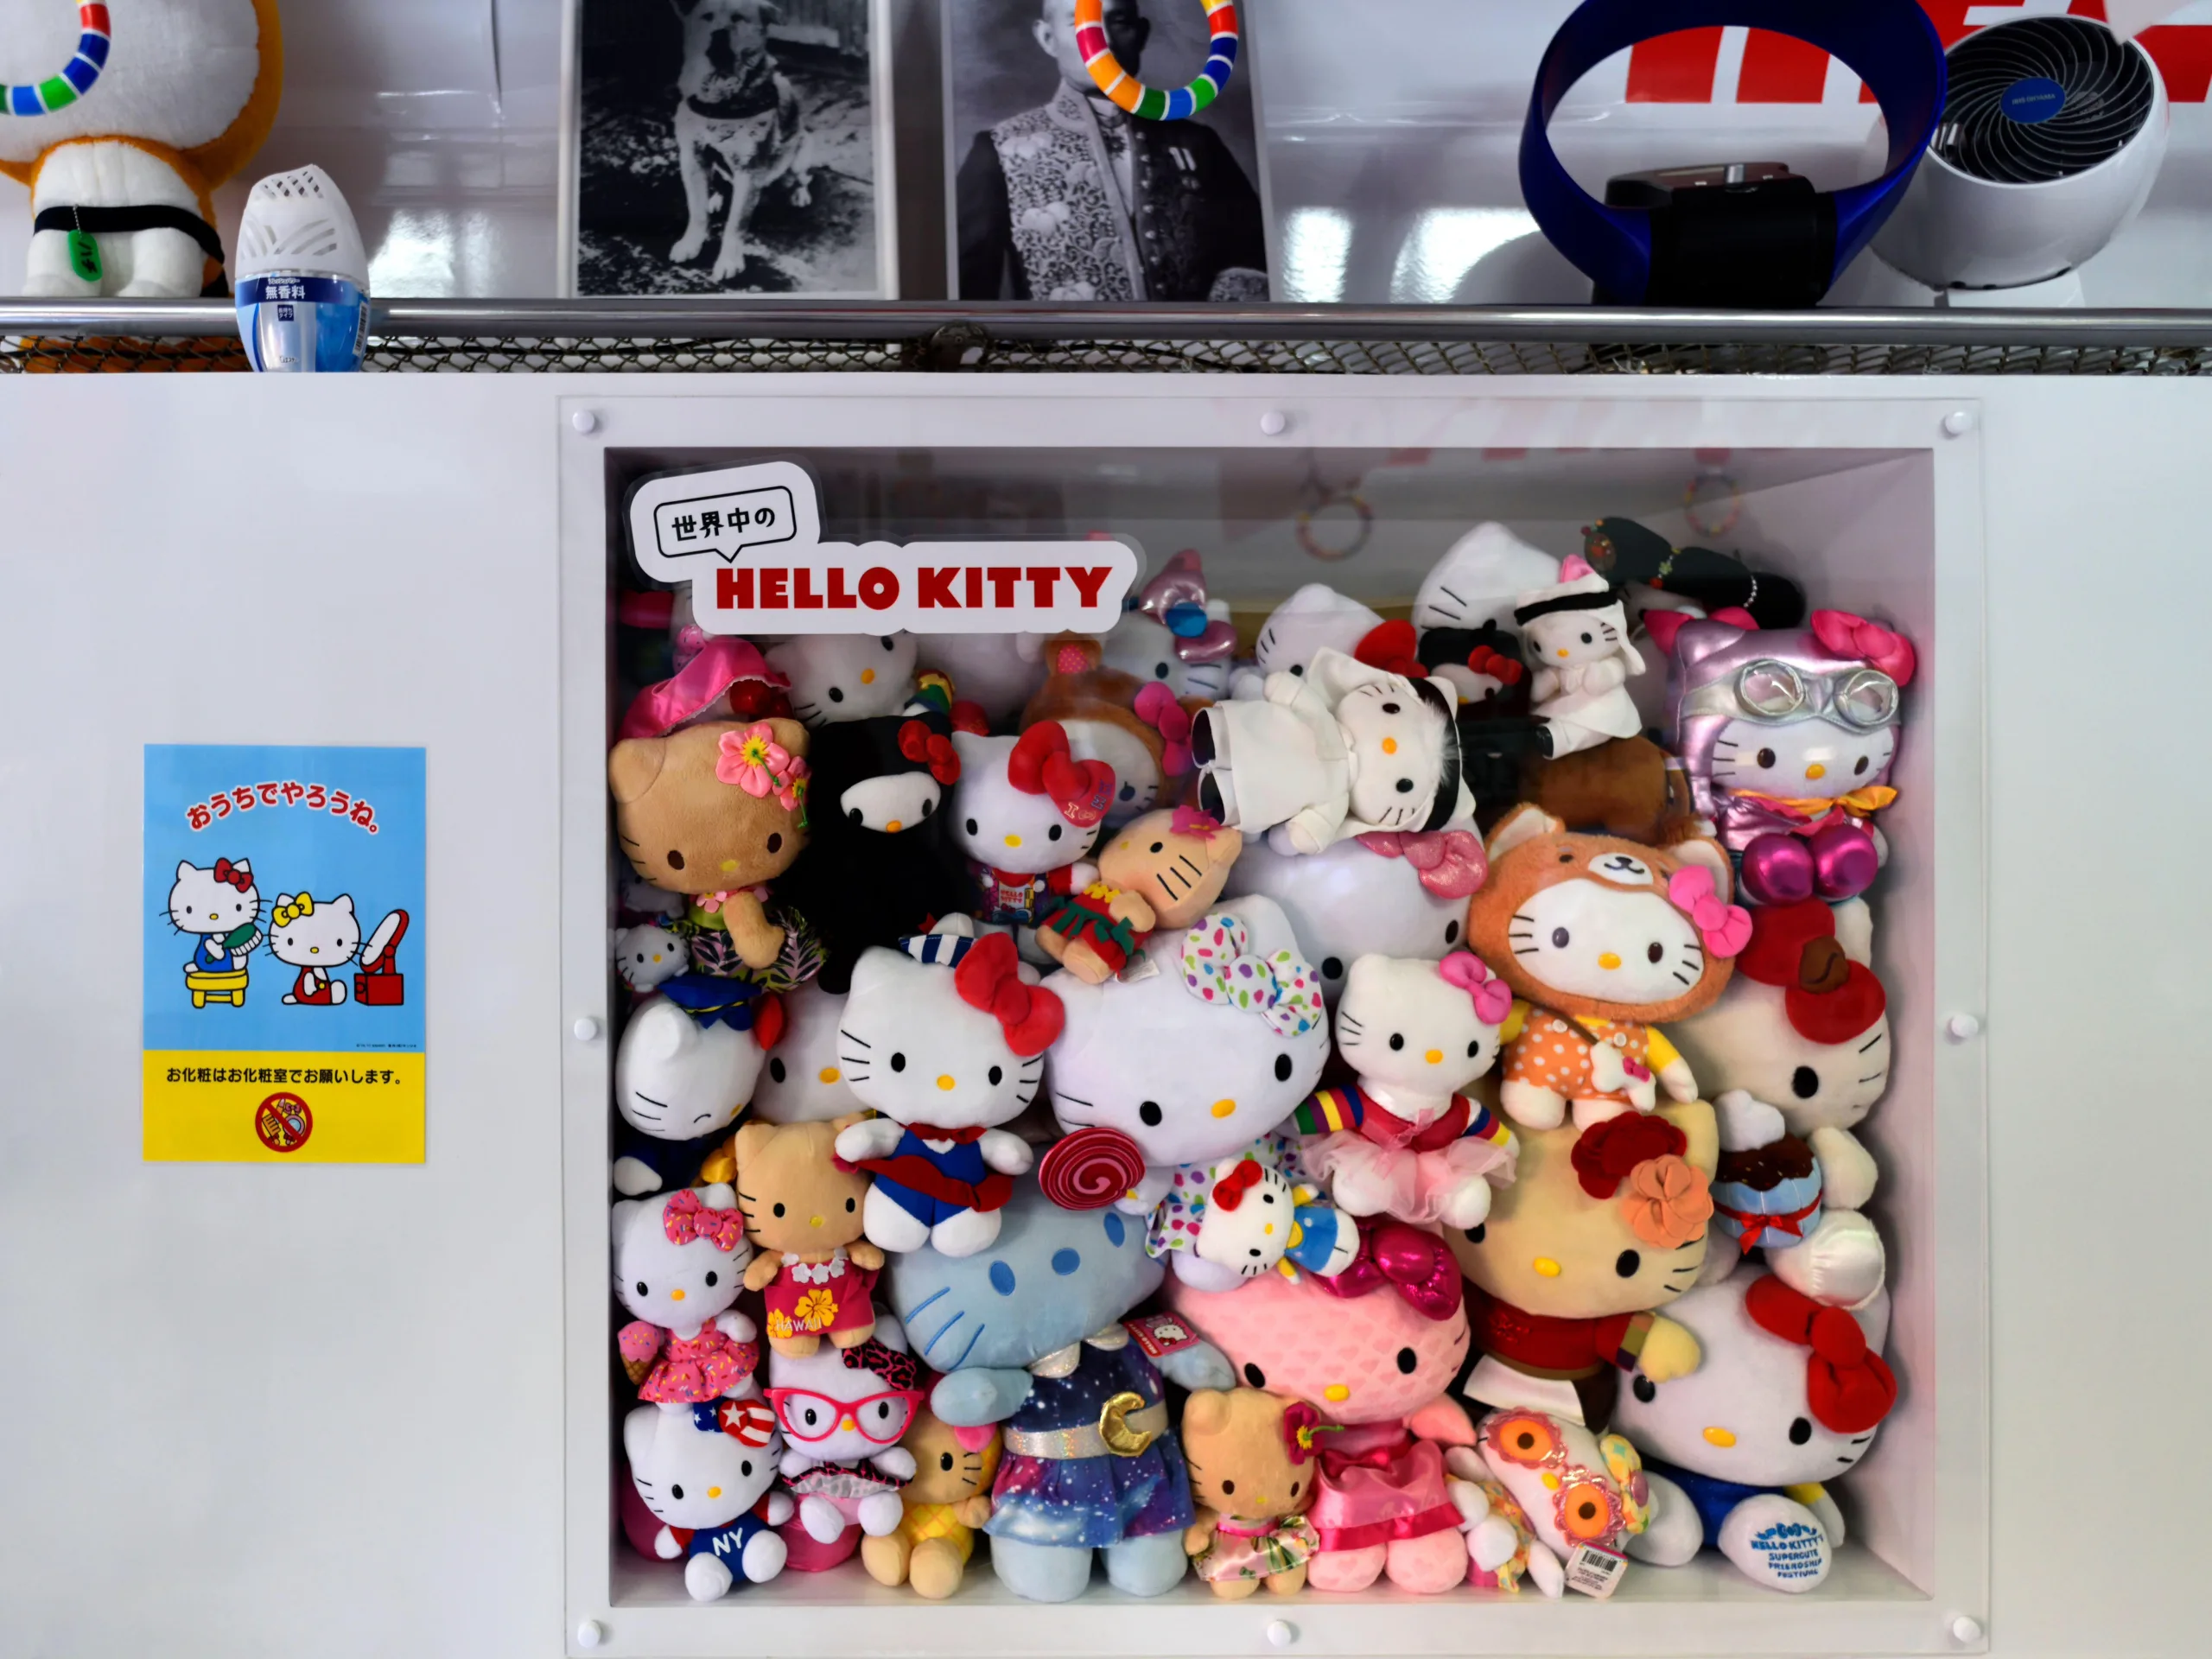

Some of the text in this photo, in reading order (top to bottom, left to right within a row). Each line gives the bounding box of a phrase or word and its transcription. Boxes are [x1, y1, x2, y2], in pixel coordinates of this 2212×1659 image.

[265, 285, 305, 299] 無香料
[671, 507, 775, 542] 世界中の
[716, 567, 1113, 610] HELLO KITTY
[187, 781, 378, 833] おうちでやろうね。
[167, 1067, 401, 1084] お化粧はお化粧室でお願いします。
[776, 1317, 822, 1332] HAWAII
[712, 1527, 743, 1556] NY
[1750, 1540, 1788, 1550] HELLO
[1769, 1549, 1819, 1560] SUPERCUTE
[1769, 1558, 1822, 1569] FRIENDSHIP
